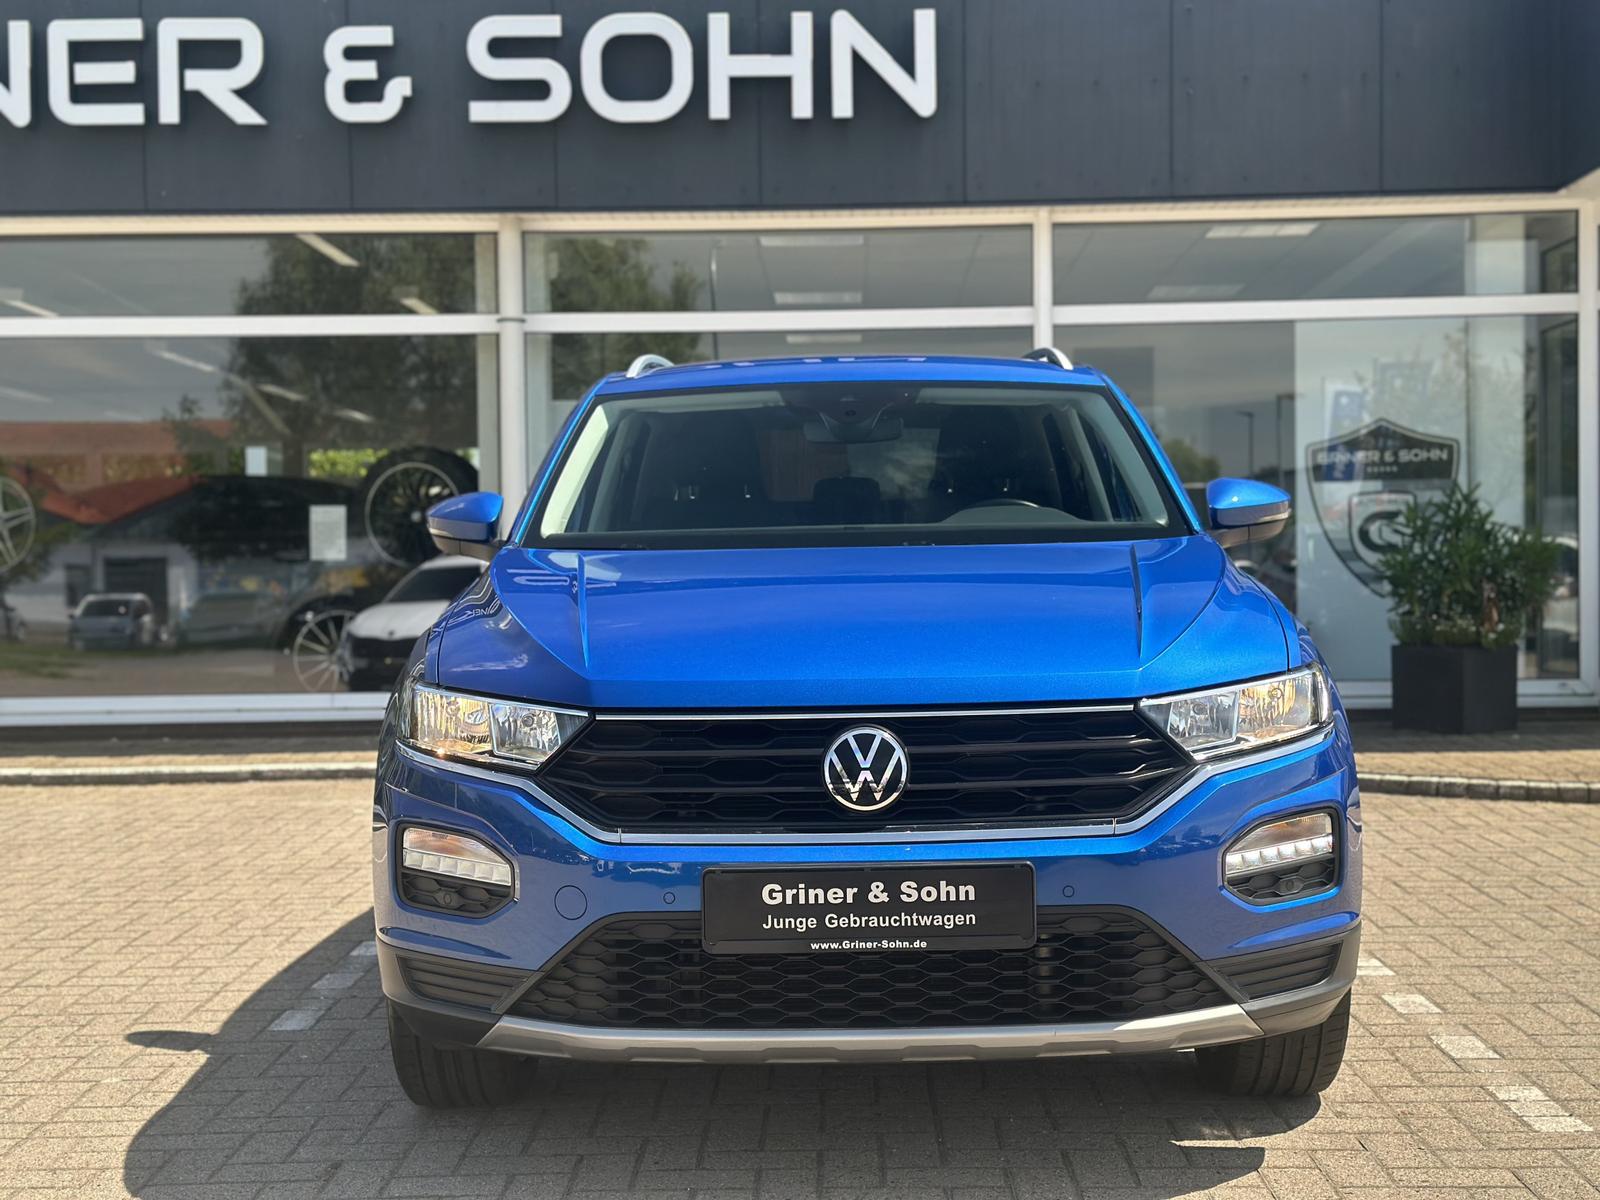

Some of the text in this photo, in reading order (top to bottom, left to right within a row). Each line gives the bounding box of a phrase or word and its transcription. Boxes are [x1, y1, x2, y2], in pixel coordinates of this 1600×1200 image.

[323, 25, 412, 123] &
[466, 8, 937, 123] SOHN
[1398, 449, 1448, 463] SOHN
[762, 881, 976, 905] Griner & Sohn
[763, 913, 976, 932] Junge Gebrauchtwagen
[811, 939, 927, 950] www.Griner-Sohn.de
